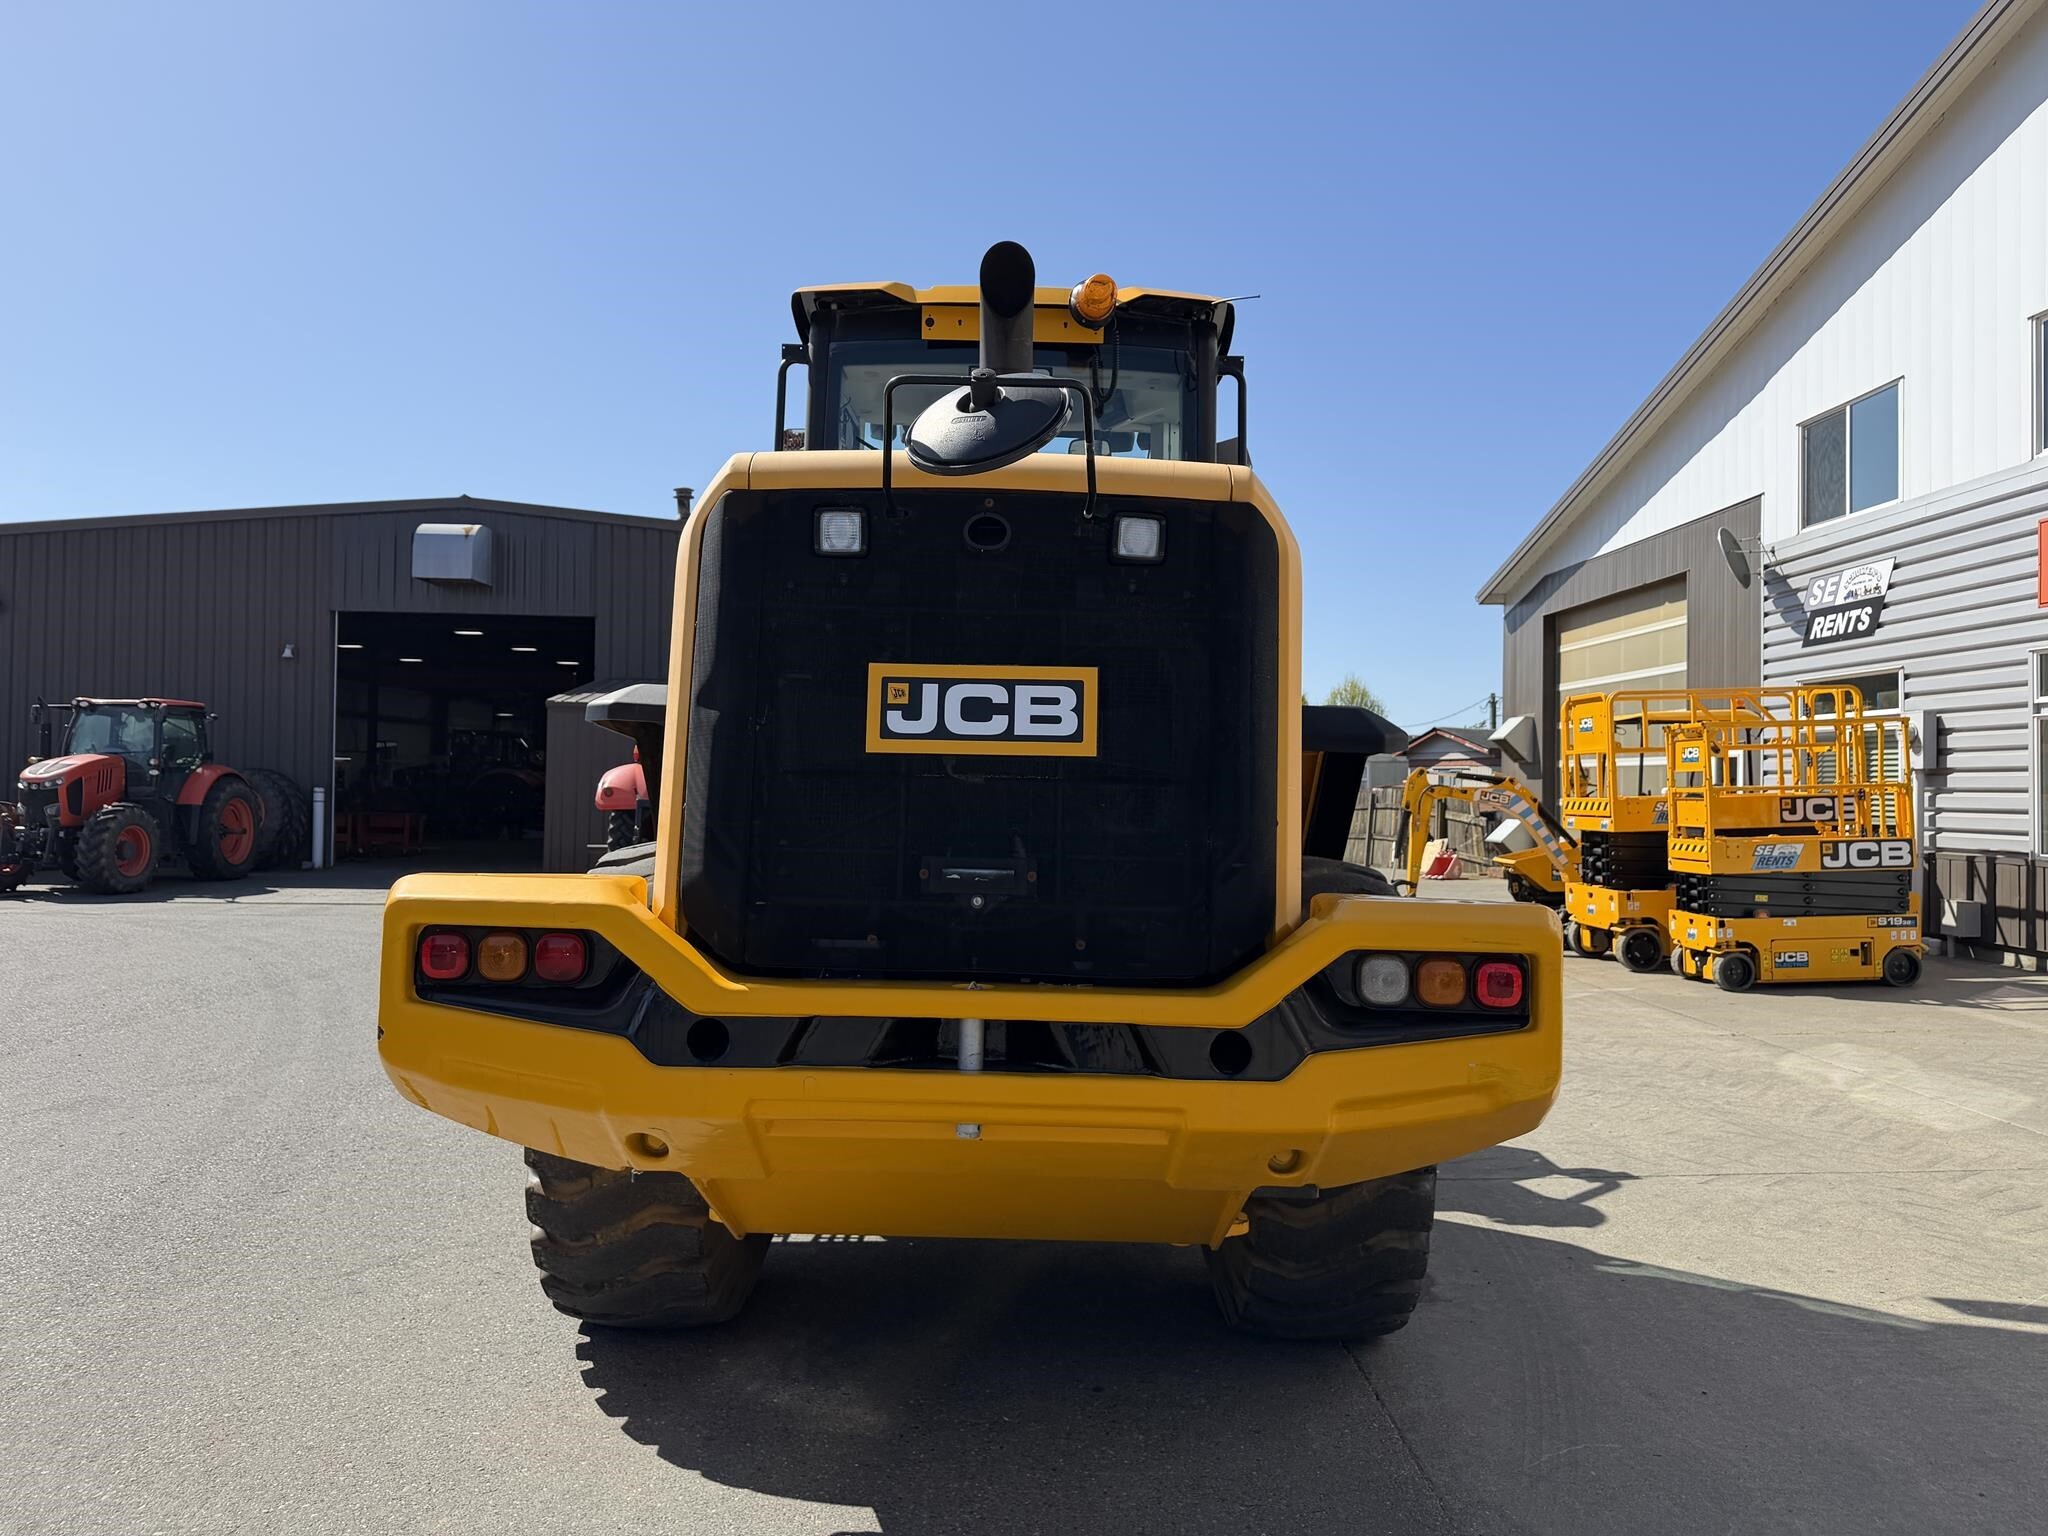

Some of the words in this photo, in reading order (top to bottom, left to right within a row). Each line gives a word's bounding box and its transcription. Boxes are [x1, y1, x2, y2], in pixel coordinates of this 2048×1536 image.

[1809, 575, 1840, 606] SE
[1809, 606, 1873, 640] RENTS
[886, 683, 1079, 737] JCB
[1579, 718, 1593, 728] JCB
[1682, 747, 1699, 758] JCB
[1481, 792, 1510, 804] JCB
[1754, 845, 1774, 856] SE
[1822, 841, 1912, 868] JCB
[1756, 855, 1795, 866] RENTS
[1775, 951, 1808, 962] JCB
